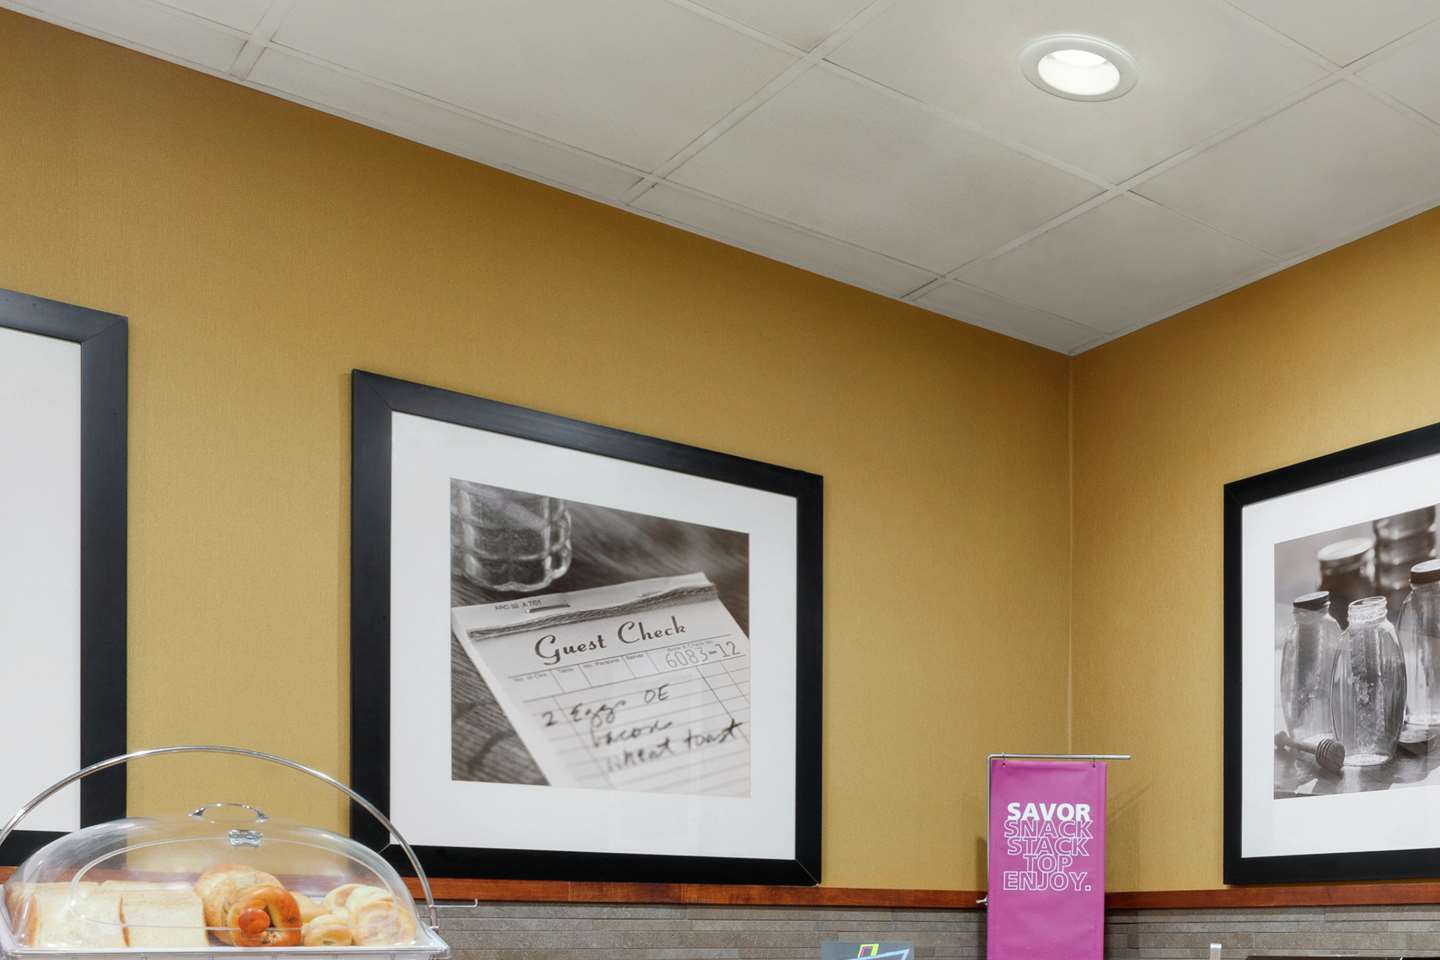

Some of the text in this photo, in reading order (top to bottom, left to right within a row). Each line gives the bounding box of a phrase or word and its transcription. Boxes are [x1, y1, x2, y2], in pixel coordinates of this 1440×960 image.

[535, 616, 687, 665] Guest Check
[542, 711, 557, 727] 2
[1007, 802, 1091, 821] SAVOR
[1003, 820, 1094, 839] SNACK
[1007, 837, 1090, 856] STACK
[1023, 854, 1073, 873] TOP
[1003, 871, 1092, 892] ENJOY.
